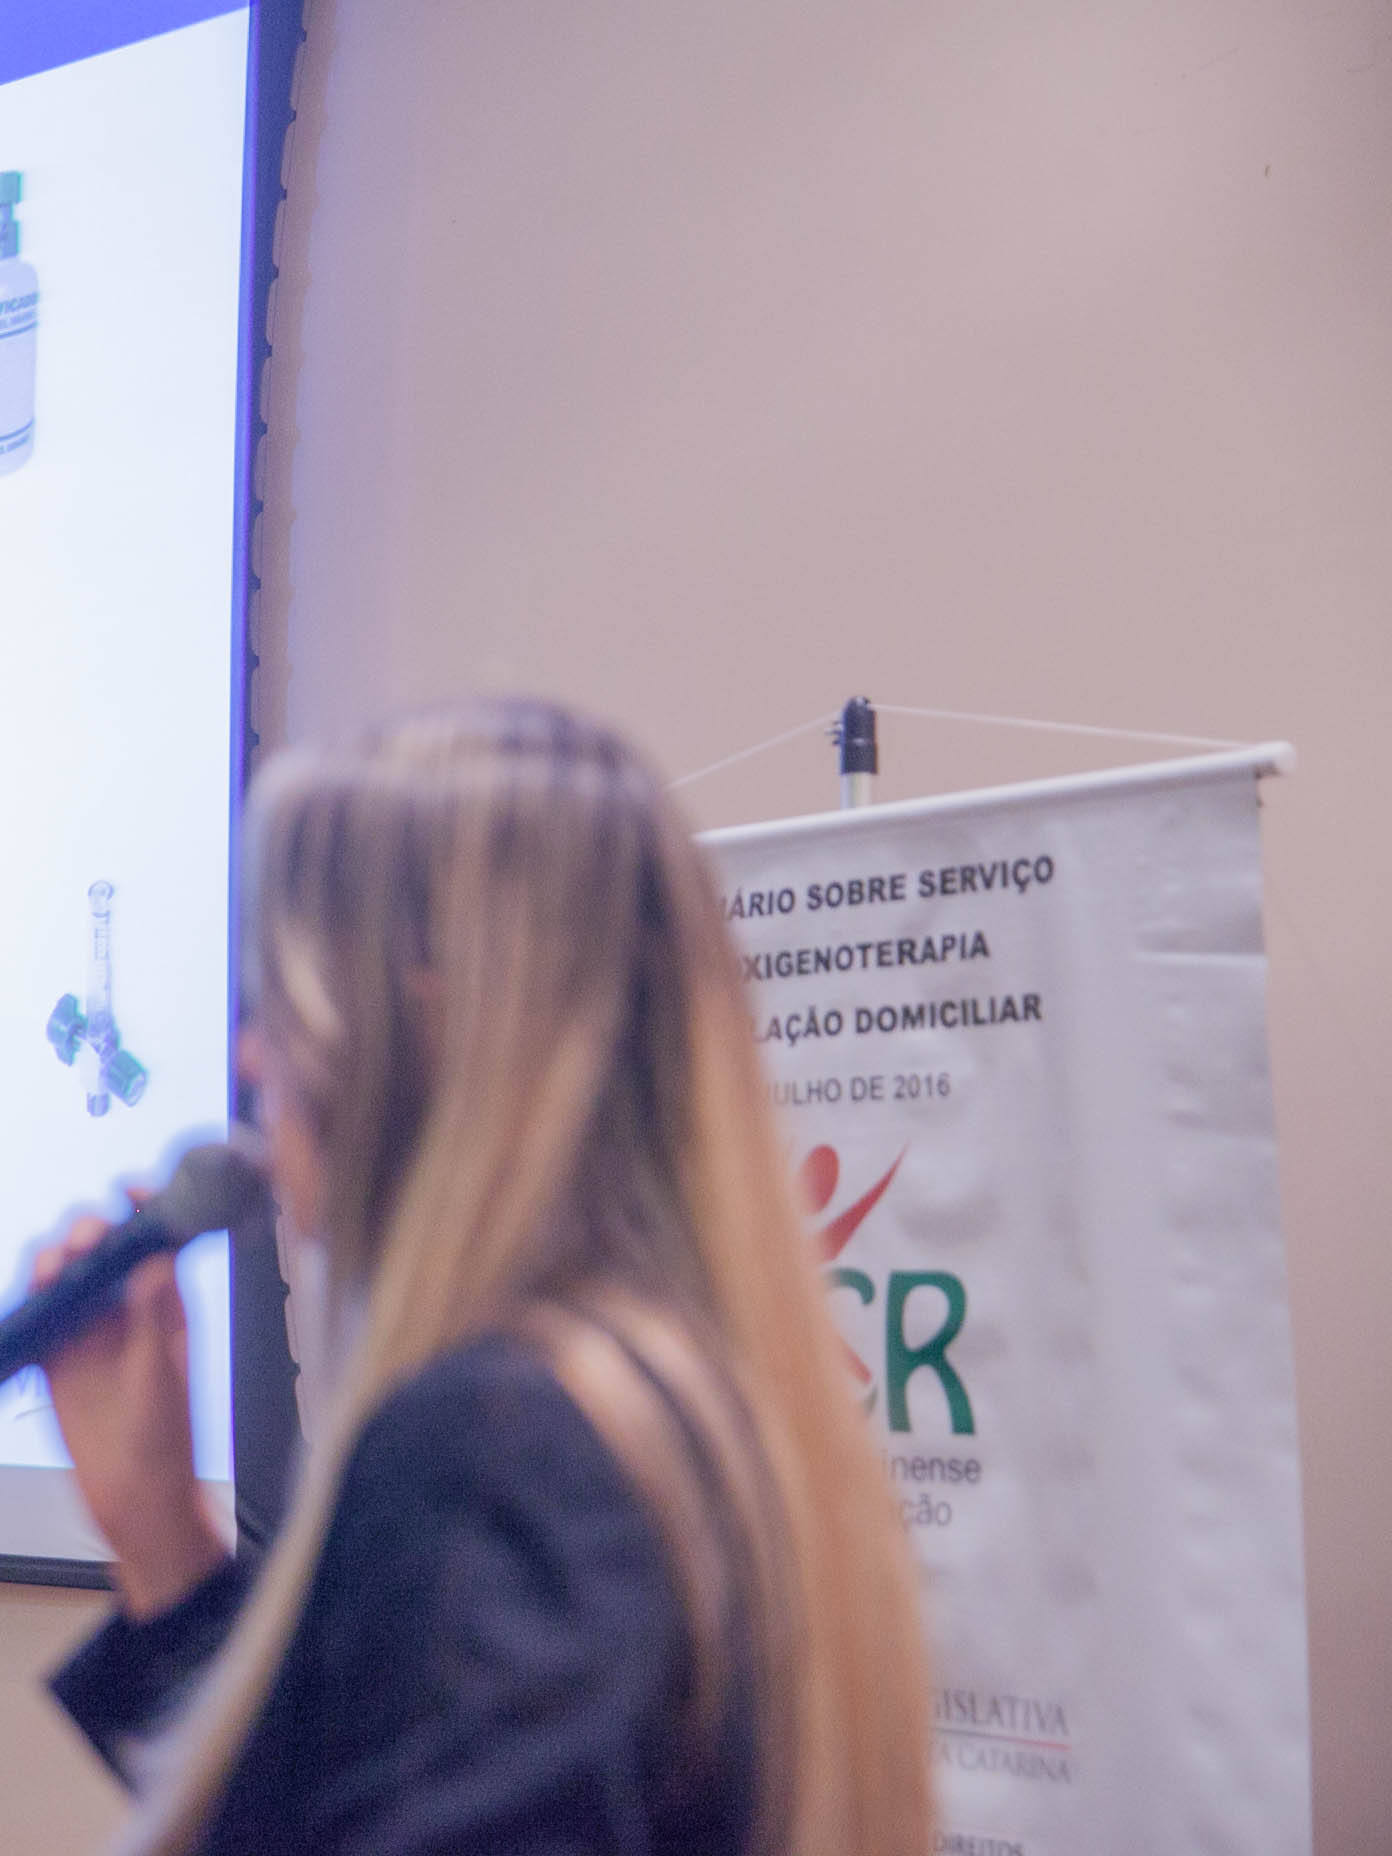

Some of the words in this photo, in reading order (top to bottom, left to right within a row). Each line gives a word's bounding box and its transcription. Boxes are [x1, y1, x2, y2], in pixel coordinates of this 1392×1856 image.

[723, 886, 795, 921] ÁRIO
[807, 875, 906, 911] SOBRE
[918, 856, 1054, 899] SERVIÇO
[743, 930, 990, 981] XIGENOTERAPIA
[855, 993, 1042, 1034] DOMICILIAR
[772, 1077, 842, 1106] ULHO
[850, 1075, 884, 1102] DE
[893, 1073, 950, 1099] 2016
[886, 1453, 982, 1485] nense
